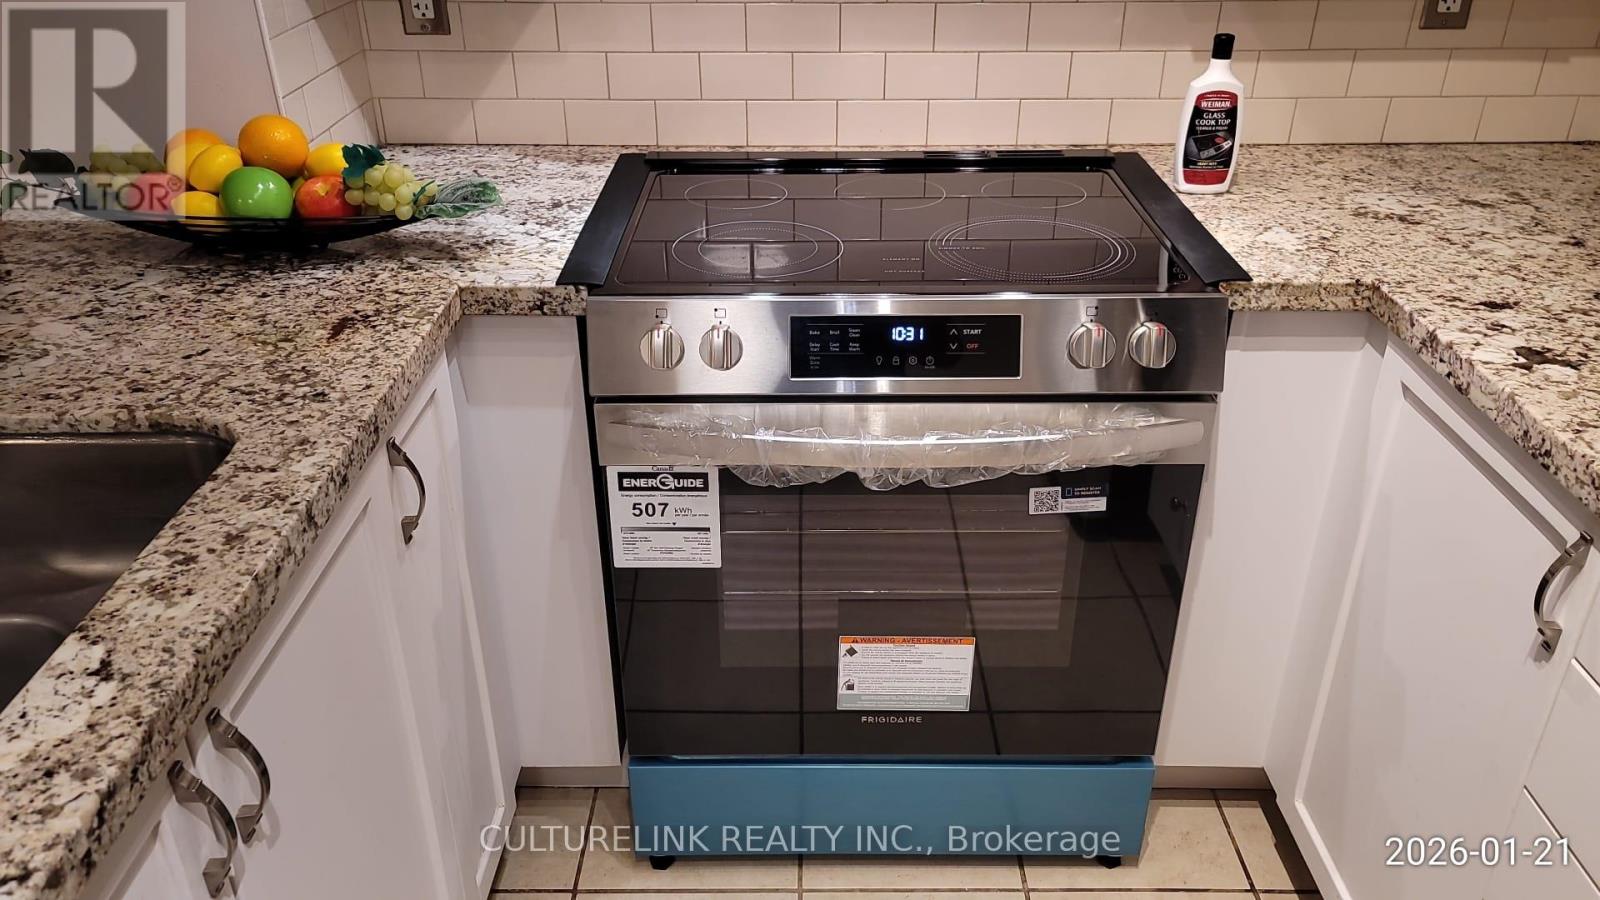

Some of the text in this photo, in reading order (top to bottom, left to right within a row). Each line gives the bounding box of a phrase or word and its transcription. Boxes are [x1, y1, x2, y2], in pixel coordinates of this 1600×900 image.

[892, 327, 924, 341] 10:31
[622, 474, 704, 490] ENERGUIDE
[632, 503, 669, 517] 507
